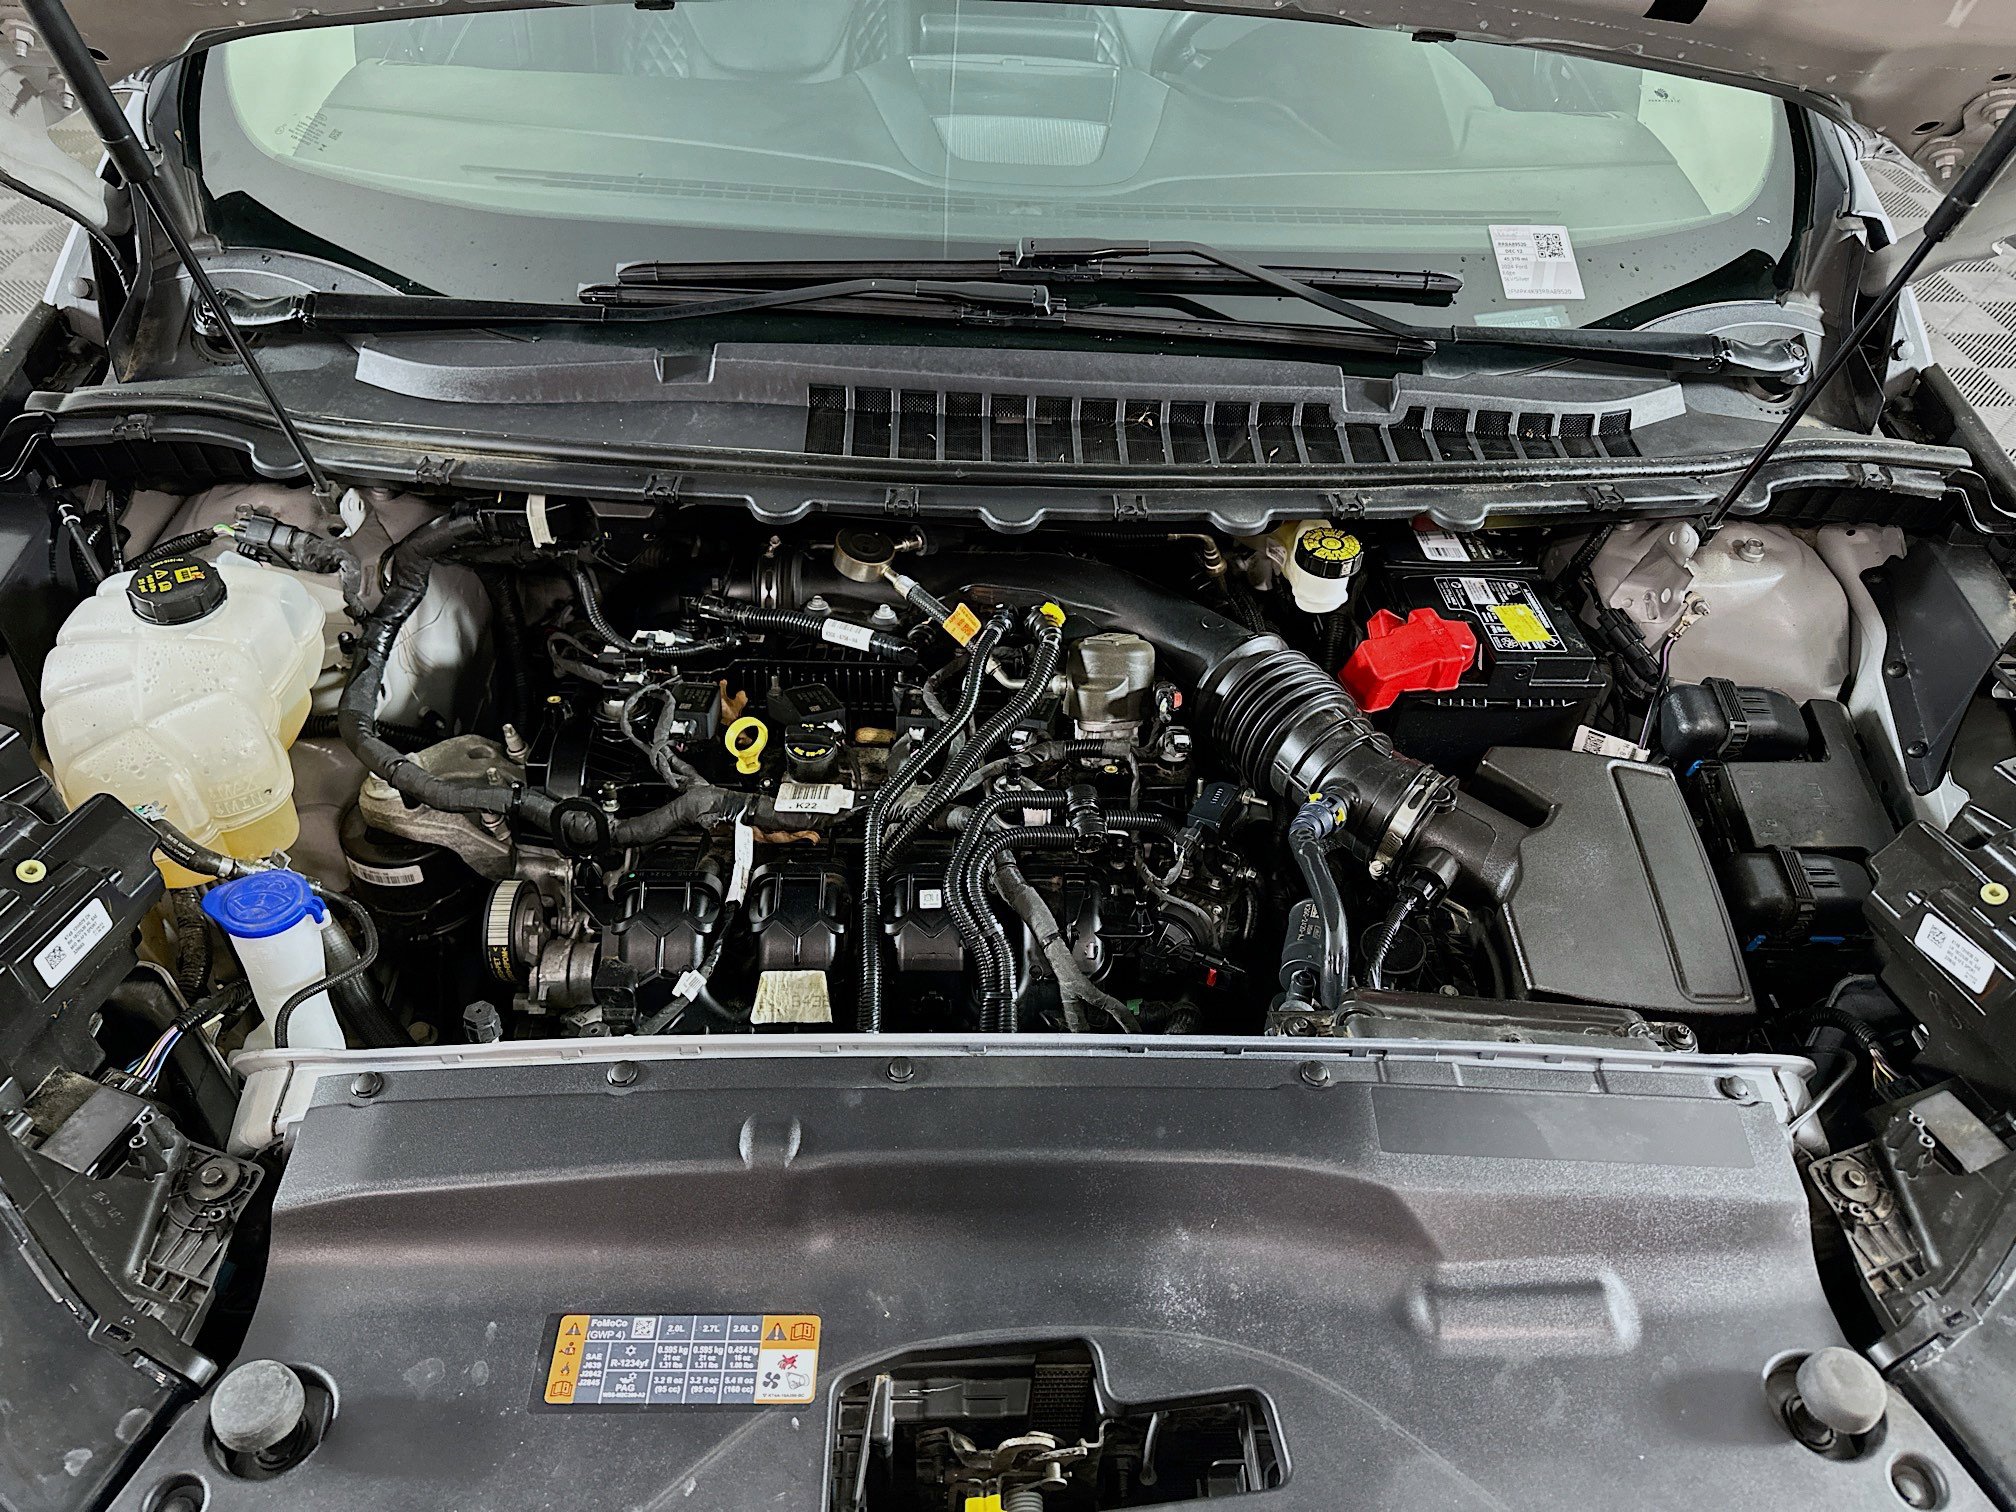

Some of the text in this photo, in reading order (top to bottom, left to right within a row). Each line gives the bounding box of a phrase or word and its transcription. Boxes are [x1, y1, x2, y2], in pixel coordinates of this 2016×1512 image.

[591, 1319, 628, 1327] FoMoCo
[587, 1331, 626, 1340] (GWP 4)
[679, 1346, 688, 1355] kg
[714, 1346, 724, 1355] kg
[749, 1346, 758, 1355] kg
[610, 1359, 649, 1368] R-1234yf
[615, 1383, 635, 1391] PAG
